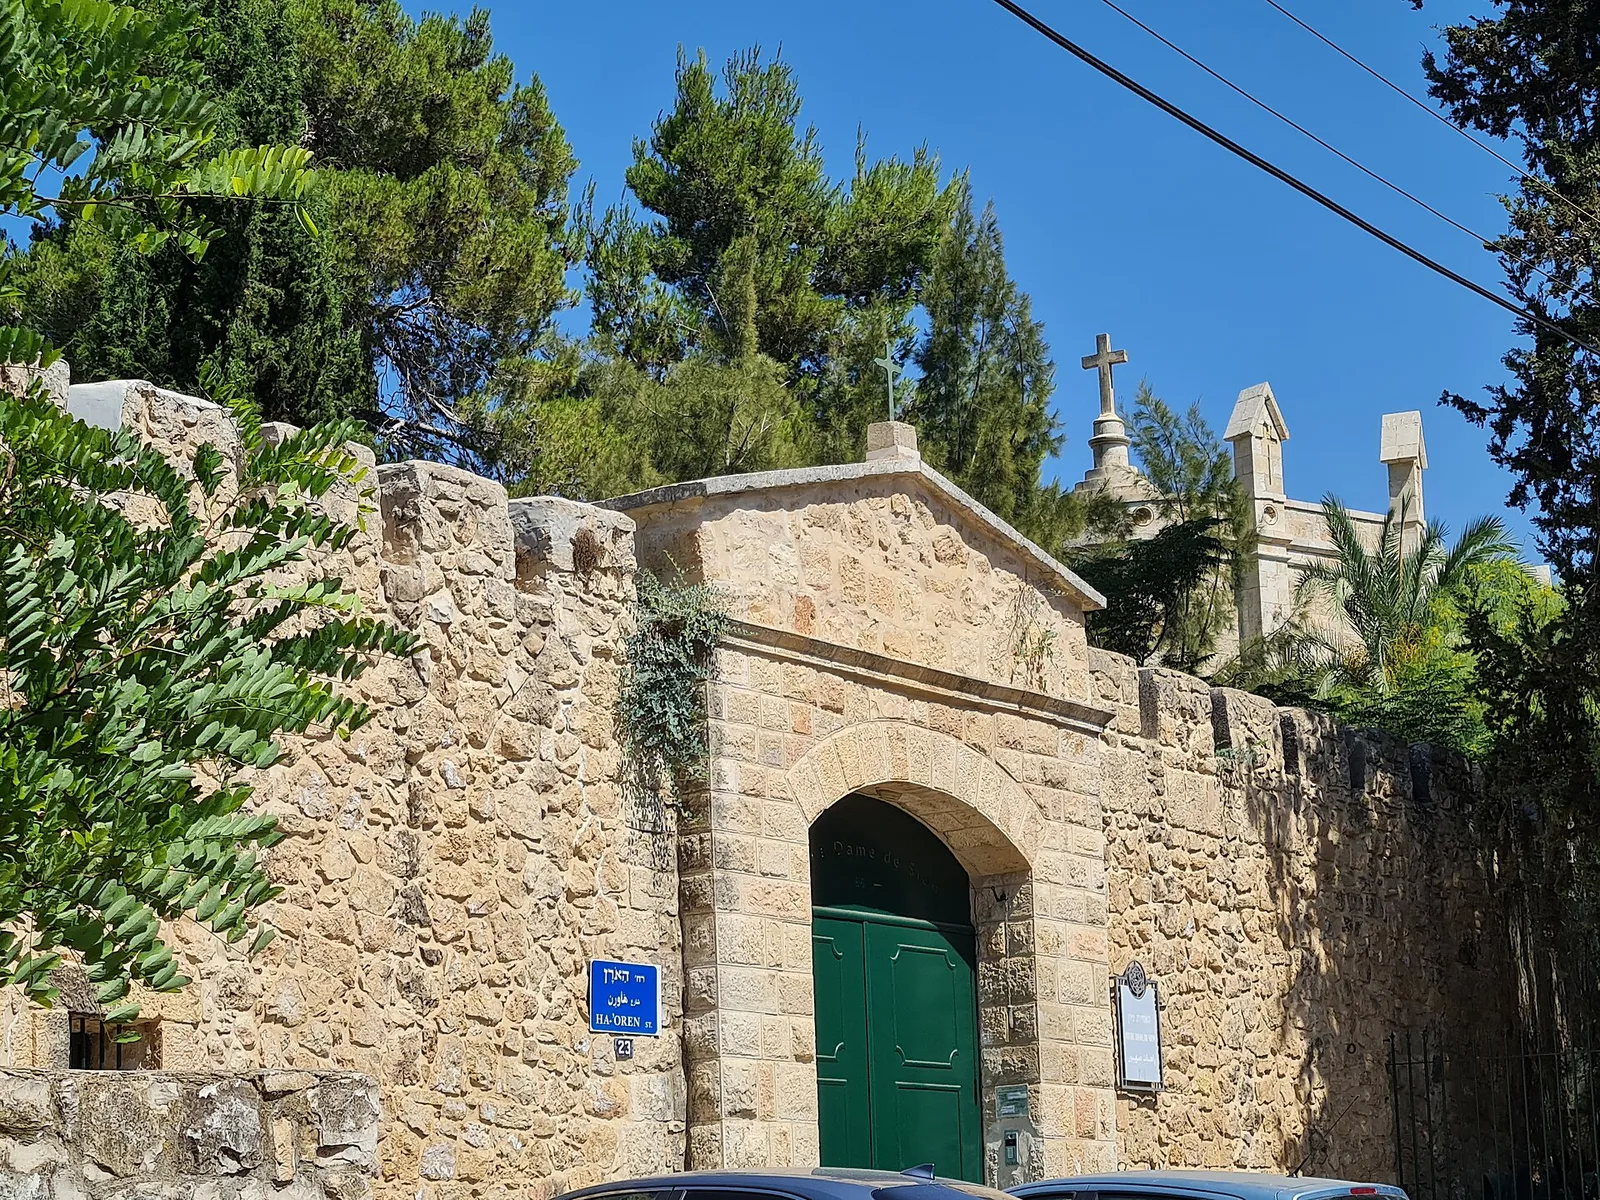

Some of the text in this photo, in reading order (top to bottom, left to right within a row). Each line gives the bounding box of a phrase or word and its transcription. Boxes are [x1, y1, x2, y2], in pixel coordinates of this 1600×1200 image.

[833, 840, 875, 858] Dame
[884, 850, 900, 868] de
[617, 1040, 631, 1055] 23
